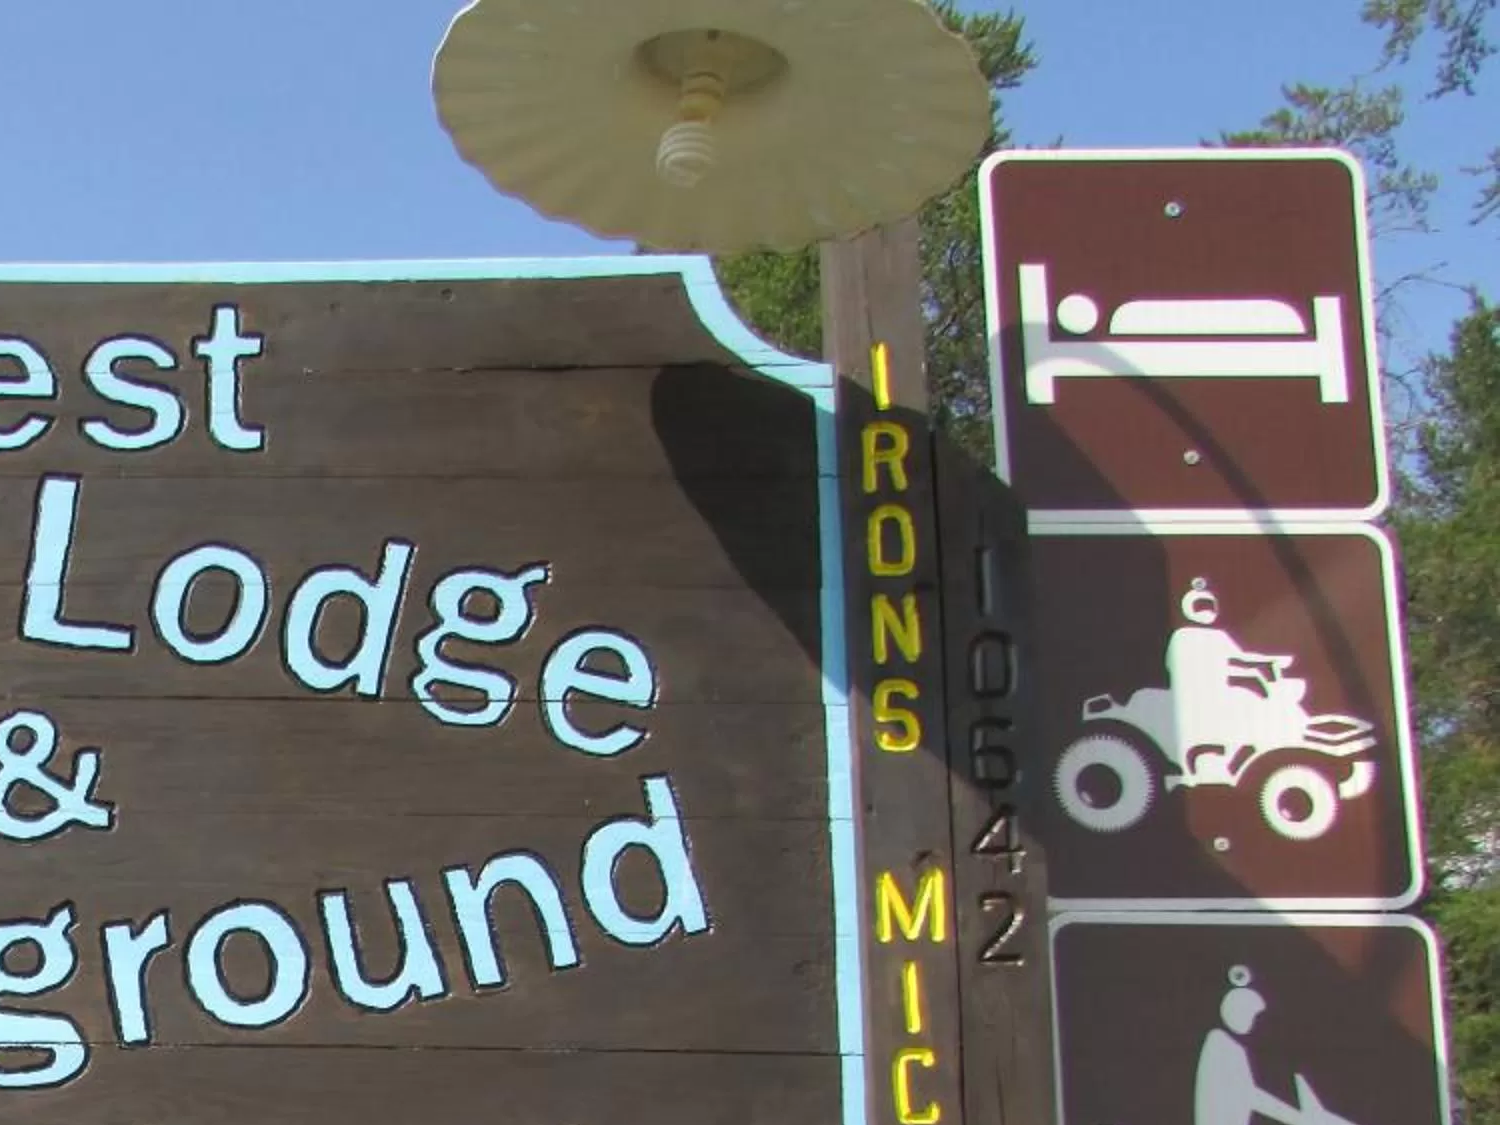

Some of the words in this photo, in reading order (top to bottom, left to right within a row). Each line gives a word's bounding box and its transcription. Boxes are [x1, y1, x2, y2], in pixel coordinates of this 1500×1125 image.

[22, 474, 658, 757] Lodge
[862, 339, 922, 754] IRONS
[965, 543, 1026, 968] 10642
